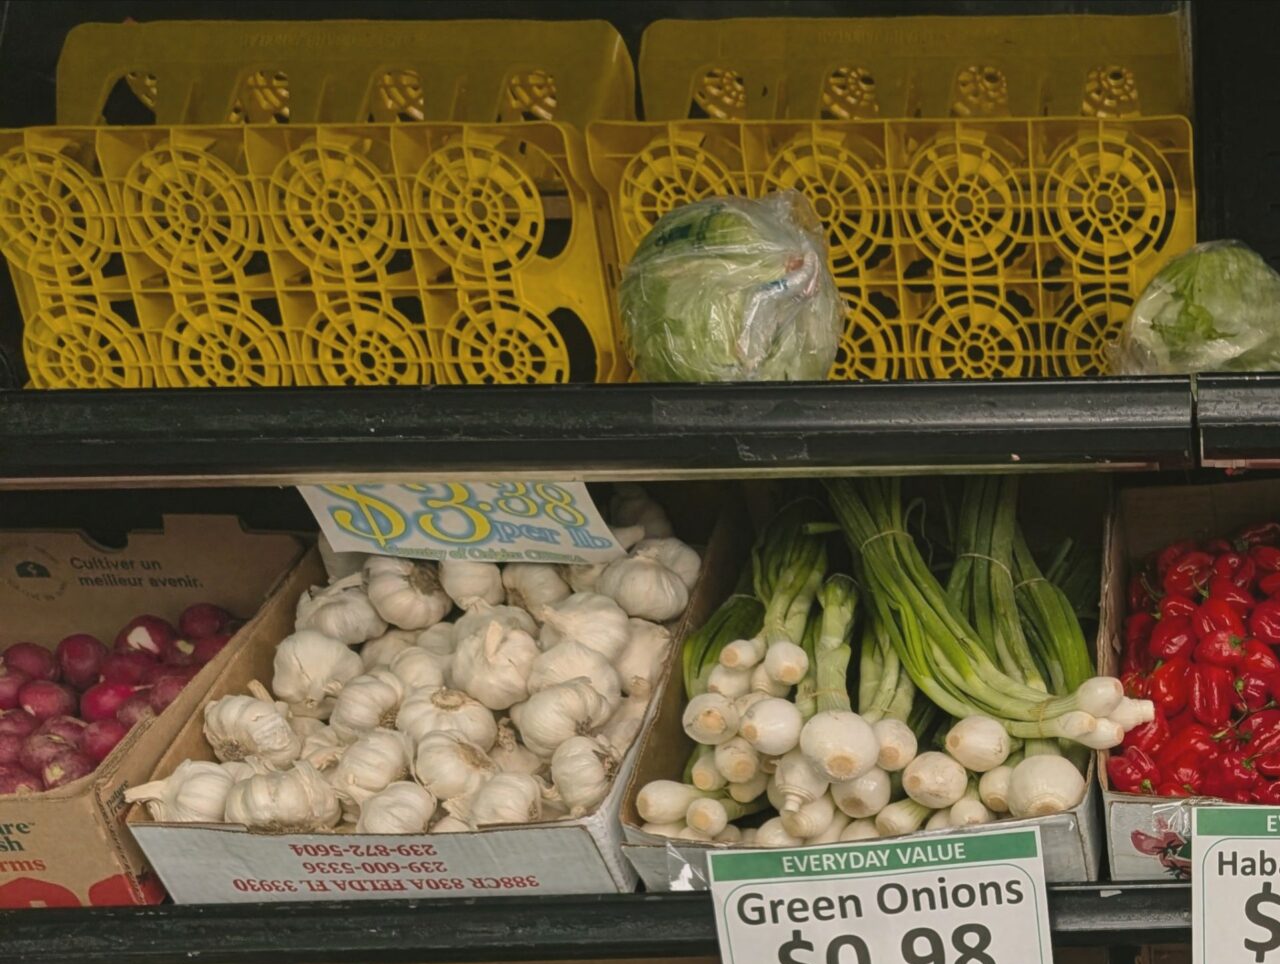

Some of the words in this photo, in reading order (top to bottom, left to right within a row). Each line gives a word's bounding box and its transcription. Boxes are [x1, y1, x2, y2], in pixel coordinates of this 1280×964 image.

[494, 518, 561, 545] per
[566, 526, 613, 549] lb
[70, 556, 135, 570] Cultiver
[141, 560, 162, 570] un
[79, 574, 143, 587] meilleur
[149, 576, 204, 588] avenir.
[289, 843, 437, 856] 239-872-5604
[782, 849, 890, 874] EVERYDAY
[897, 842, 966, 865] VALUE
[302, 860, 447, 874] 239-600-5336
[232, 878, 297, 892] 33930
[299, 879, 331, 892] FL
[331, 879, 408, 892] FELDA
[406, 878, 464, 890] 830A
[467, 875, 540, 888] 388CR
[737, 892, 863, 926] Green
[877, 877, 1024, 915] Onions
